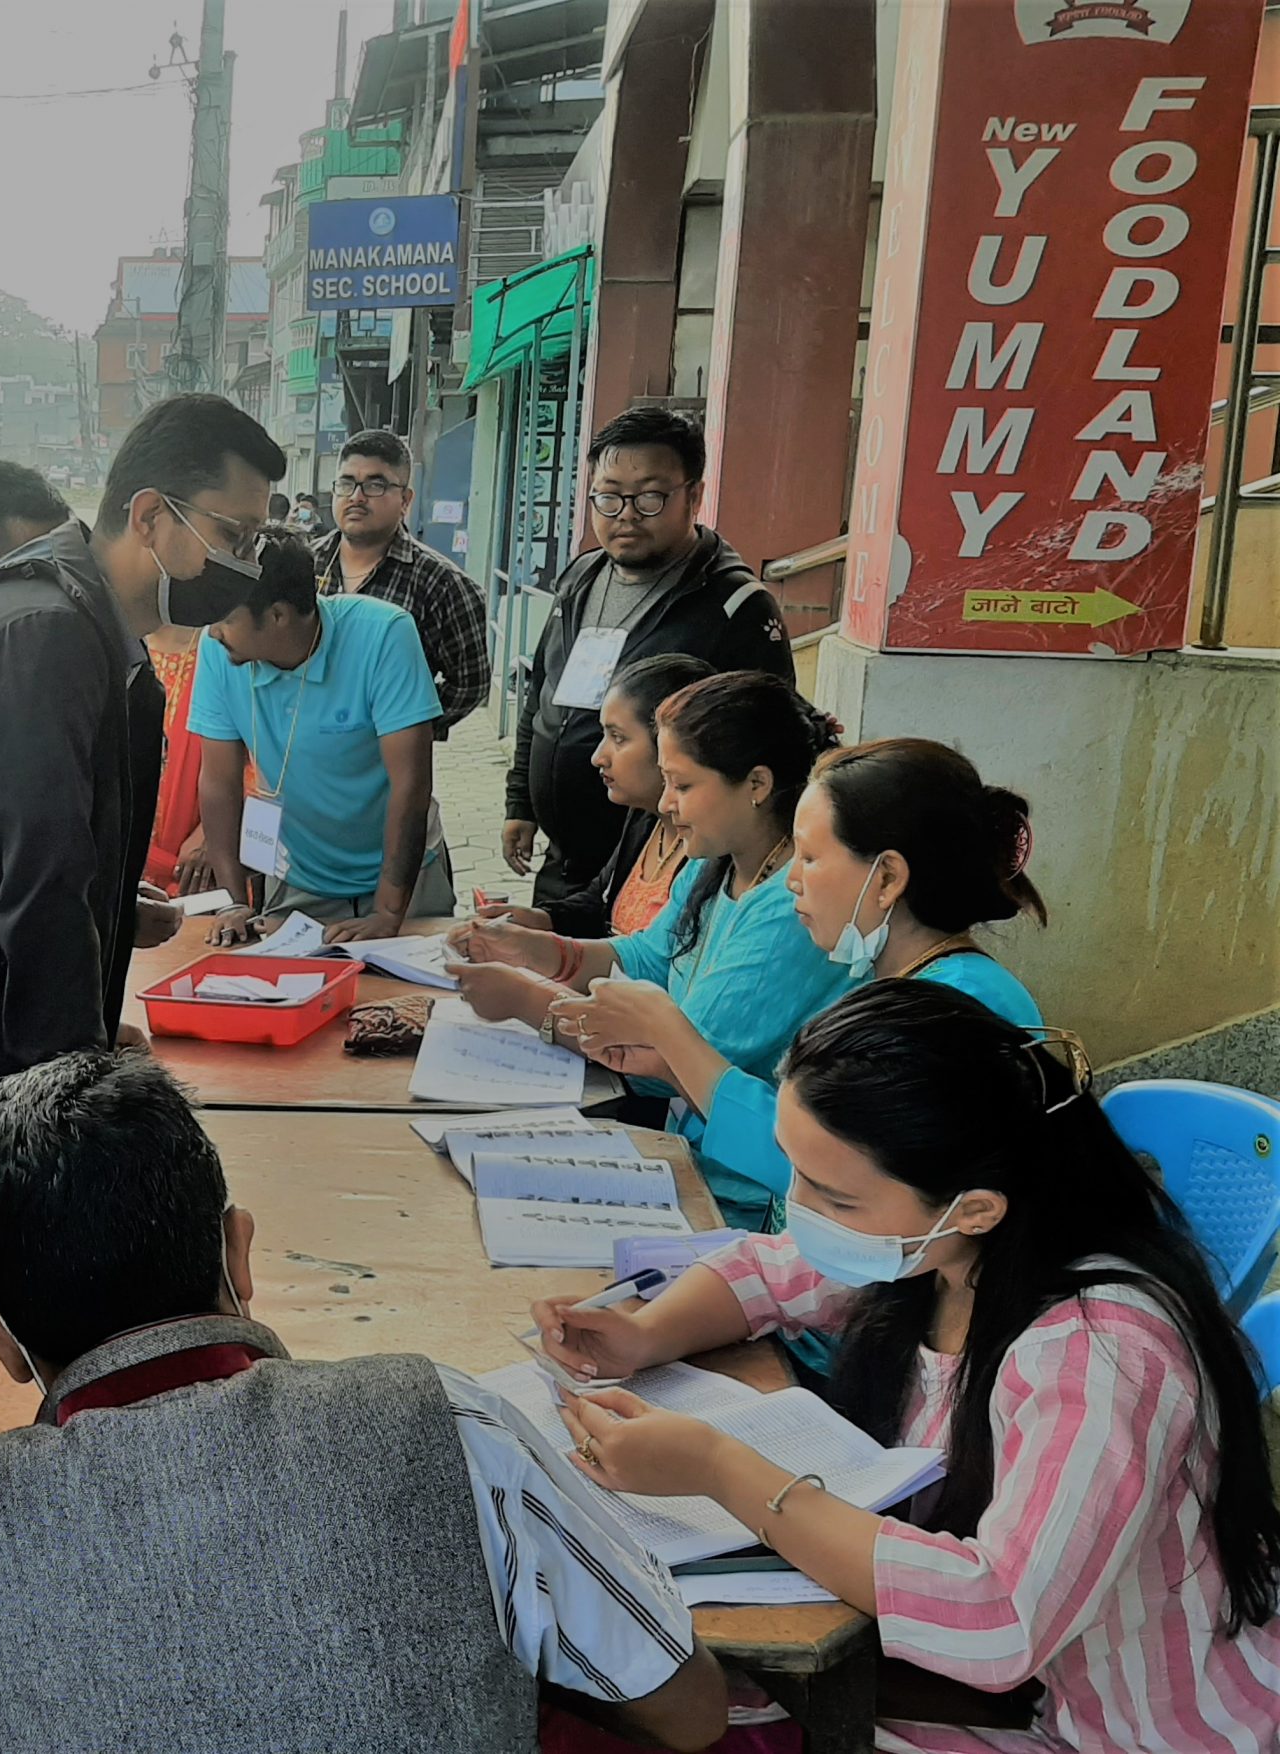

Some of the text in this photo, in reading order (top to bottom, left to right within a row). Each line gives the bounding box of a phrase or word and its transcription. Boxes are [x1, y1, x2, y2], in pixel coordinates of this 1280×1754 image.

[981, 116, 1078, 142] New
[309, 242, 455, 271] MANAKAMANA
[312, 272, 451, 299] SEC. SCHOOL
[1067, 76, 1207, 561] FOODLAND
[937, 148, 1062, 559] YUMMY
[971, 595, 1080, 615] जाने बाटो
